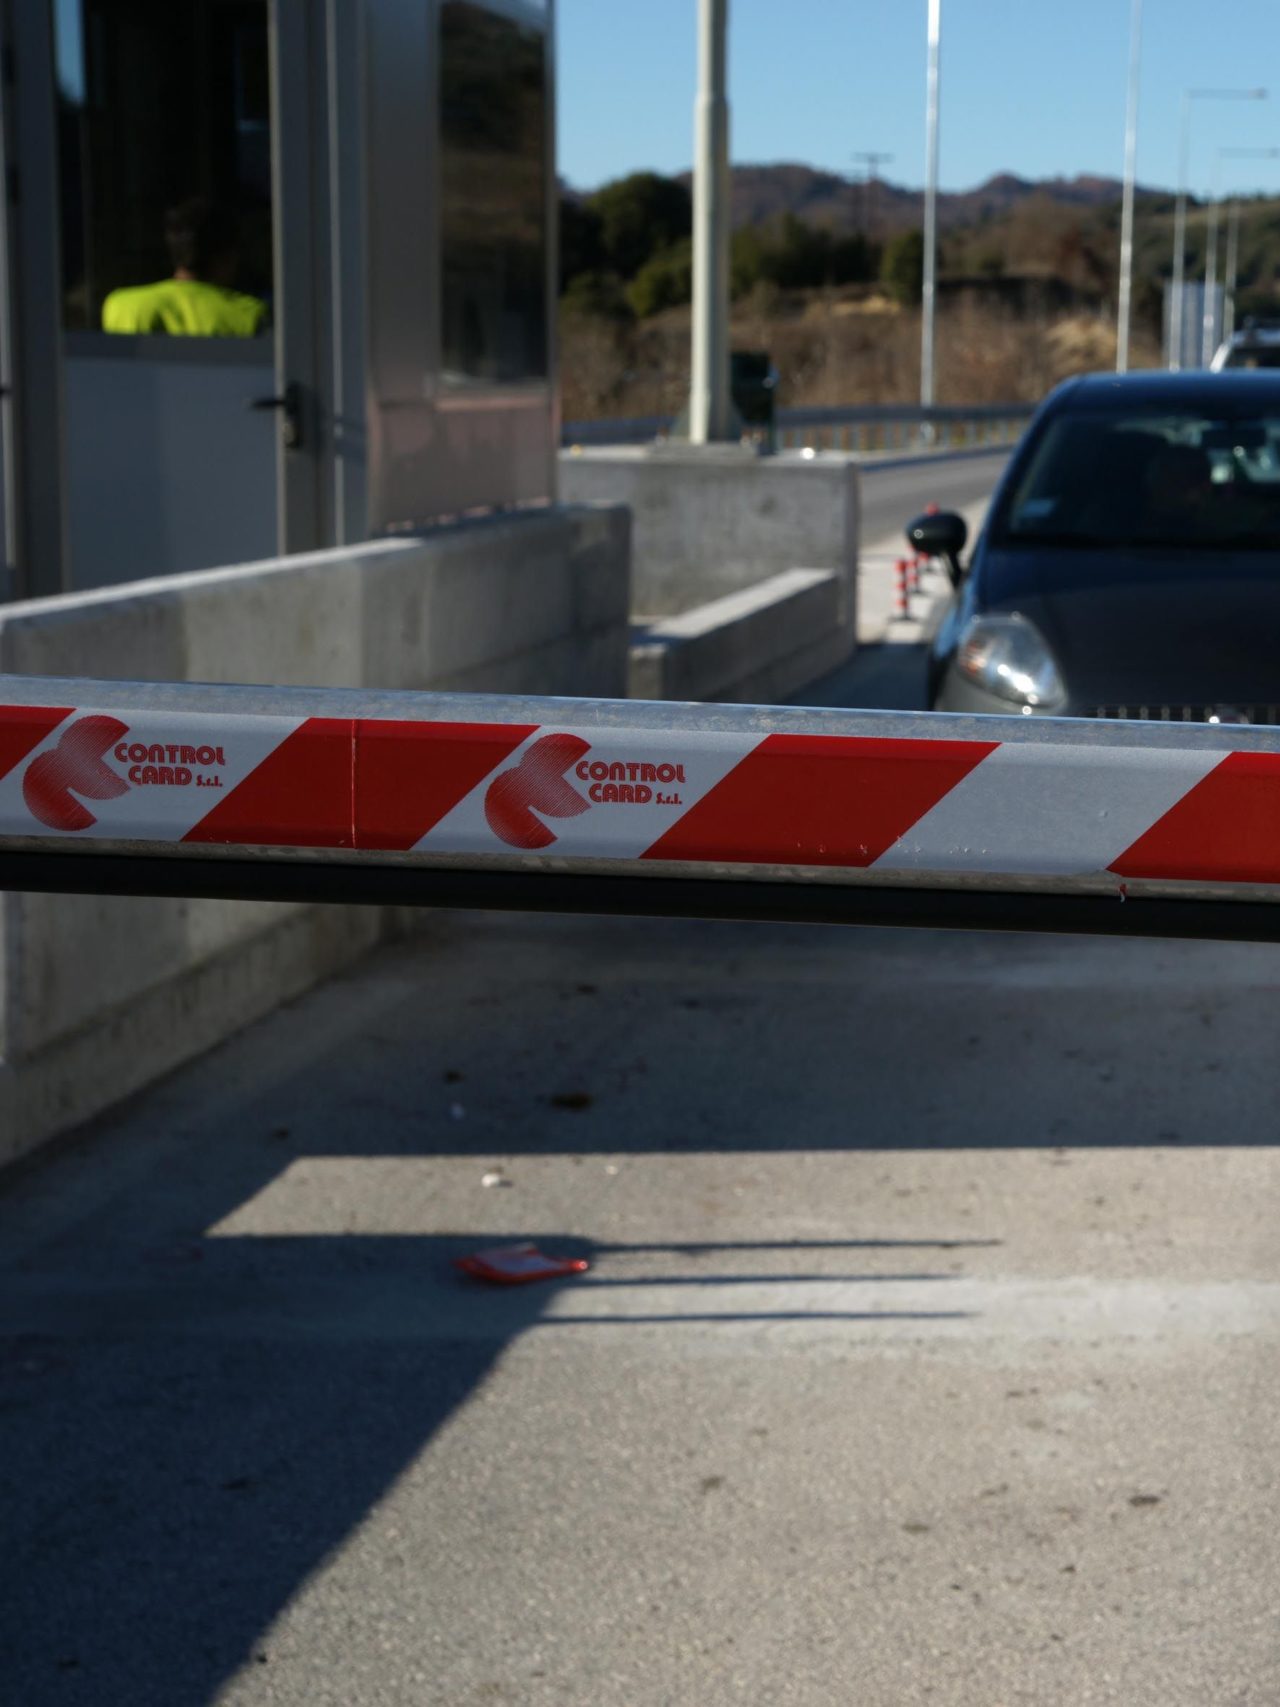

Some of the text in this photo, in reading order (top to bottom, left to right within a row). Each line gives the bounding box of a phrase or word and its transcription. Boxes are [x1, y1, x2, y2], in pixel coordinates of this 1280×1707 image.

[115, 743, 226, 765] CONTROL
[128, 765, 193, 786] CARD
[576, 761, 686, 783] CONTROL
[588, 783, 653, 803] CARD
